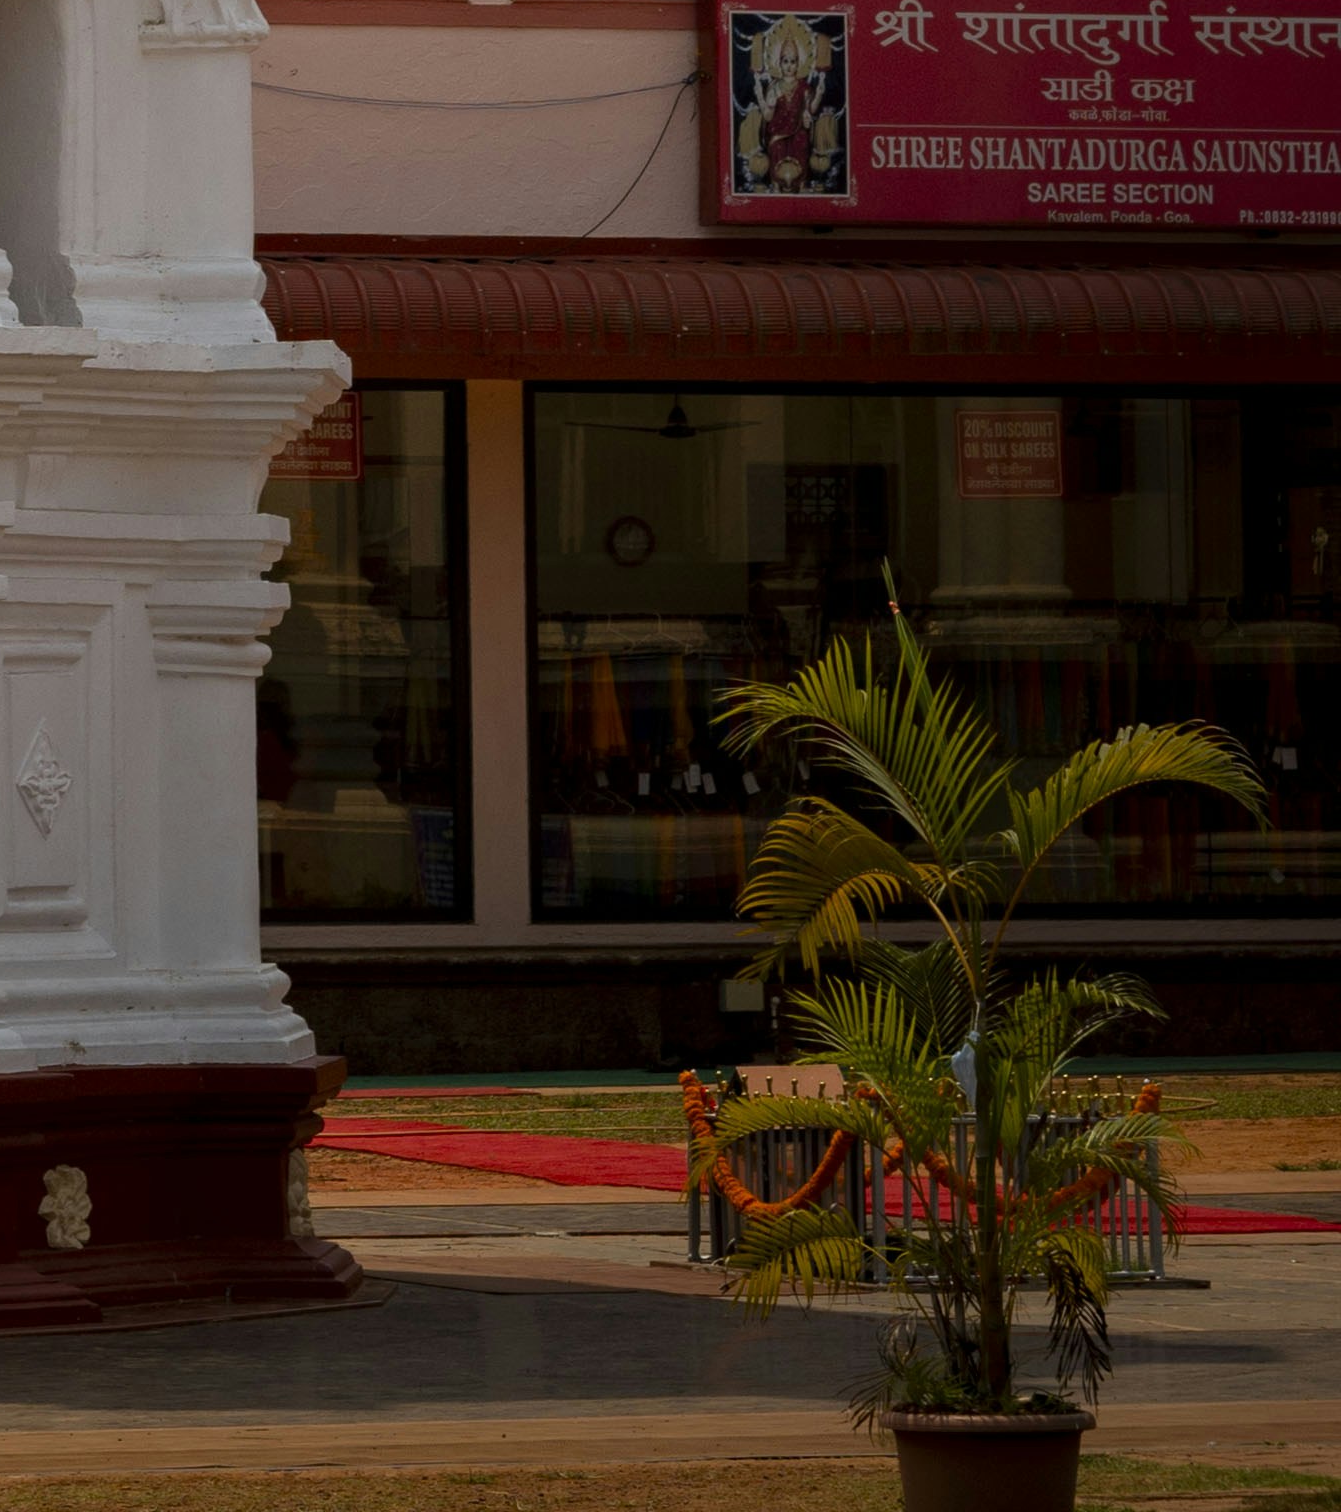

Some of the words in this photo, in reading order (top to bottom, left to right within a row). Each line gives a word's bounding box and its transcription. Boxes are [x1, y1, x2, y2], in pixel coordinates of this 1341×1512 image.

[954, 0, 1174, 66] शांतादुर्गा
[1040, 68, 1115, 102] साडी
[1130, 78, 1196, 106] कक्ष
[871, 135, 965, 169] SHREE
[969, 136, 1187, 172] SHANTADURGA
[1027, 182, 1107, 204] SAREE
[1112, 182, 1214, 205] SECTION
[1110, 209, 1153, 224] Ponda
[964, 419, 994, 438] 20%
[995, 421, 1055, 438] DISCOUNT
[964, 442, 980, 459] ON
[982, 442, 1007, 459] SILK
[1011, 442, 1056, 459] SAREES
